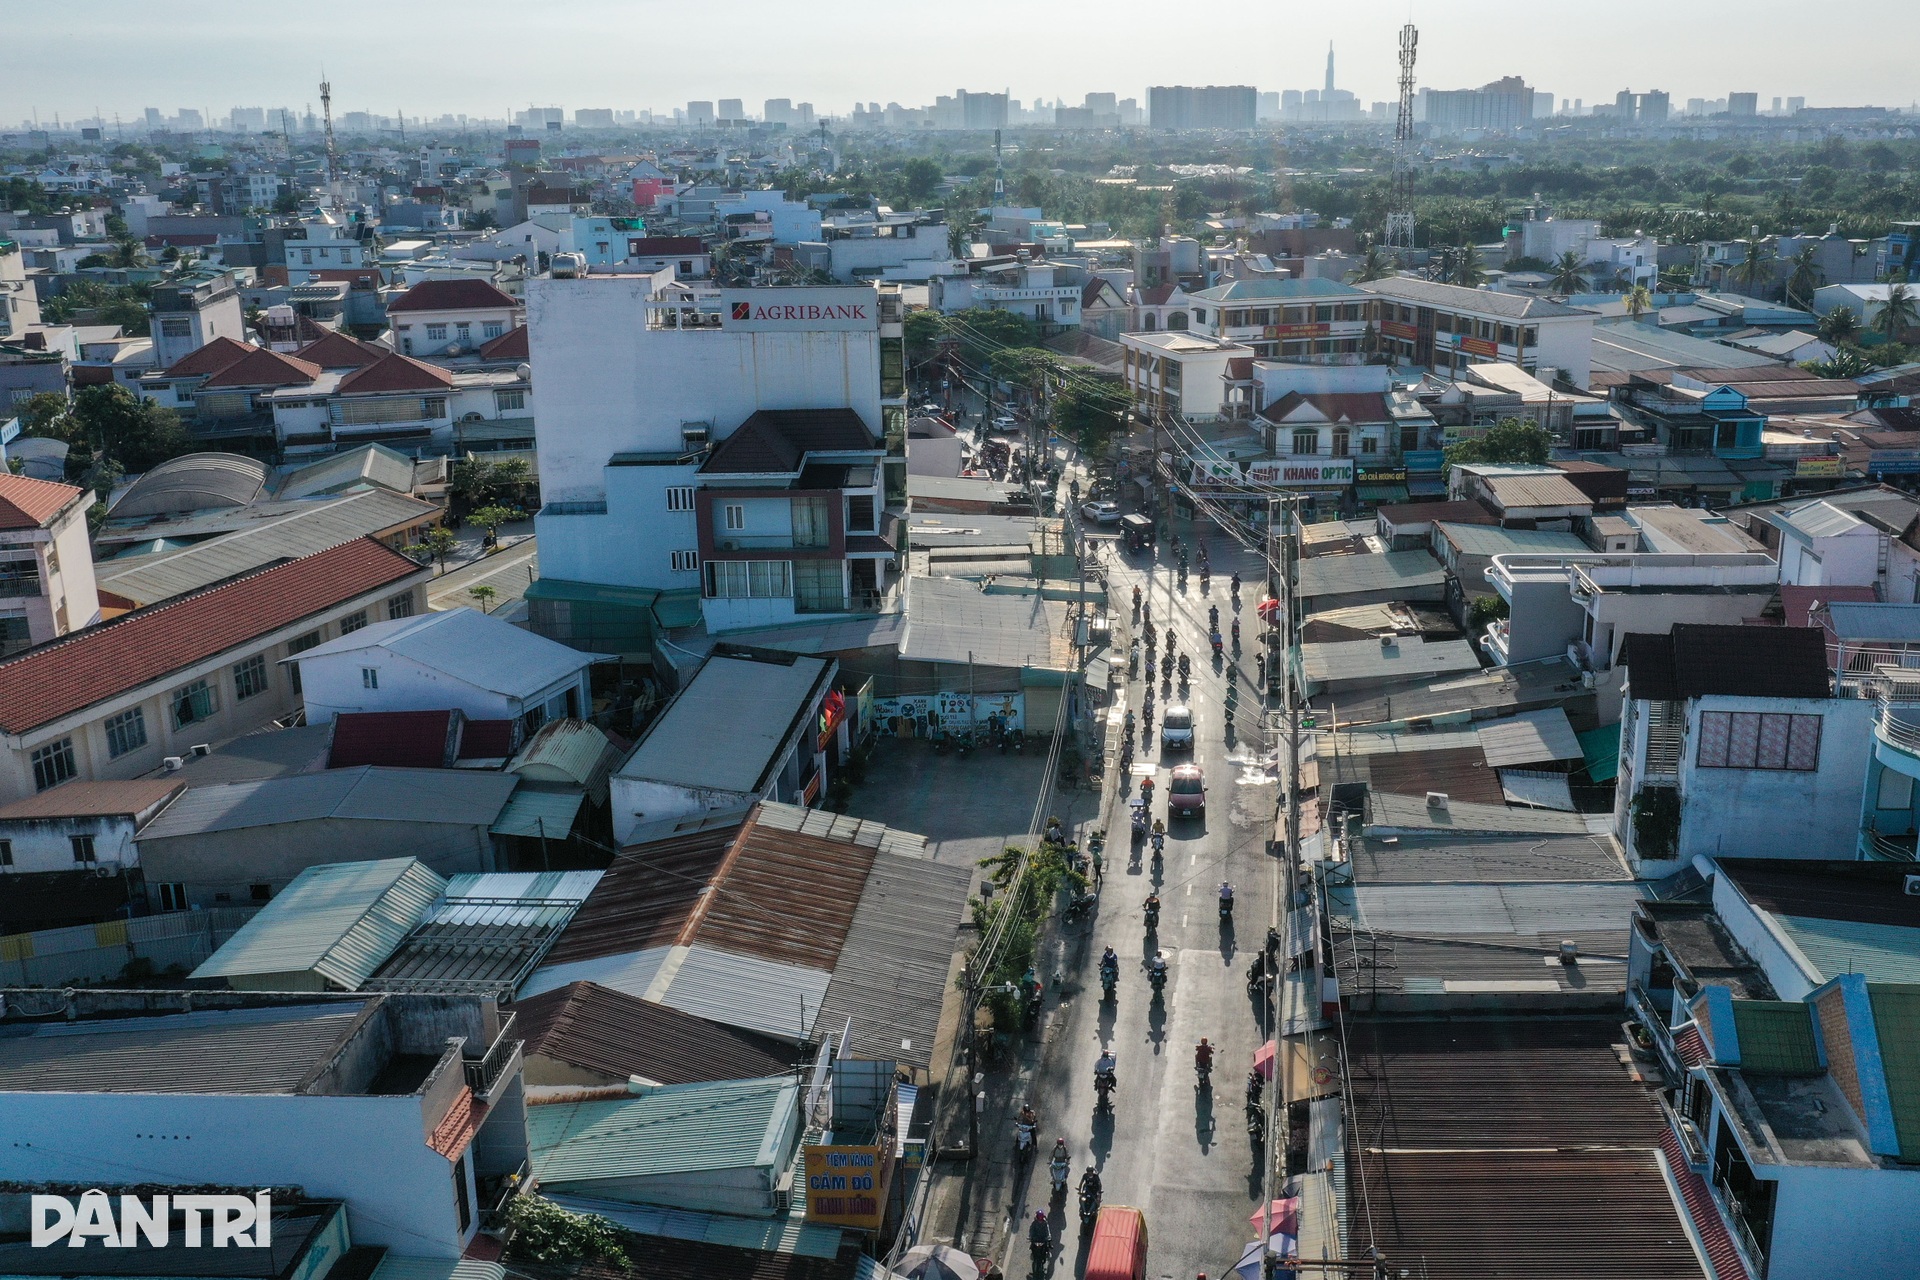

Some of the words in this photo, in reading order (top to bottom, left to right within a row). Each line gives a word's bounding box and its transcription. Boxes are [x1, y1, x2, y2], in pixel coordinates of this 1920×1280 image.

[754, 305, 867, 320] AGRIBANK
[1252, 466, 1280, 483] NHẬT
[1283, 467, 1319, 480] KHANG
[1322, 466, 1352, 480] OPTIC
[825, 1151, 848, 1169] TIỆM
[850, 1151, 874, 1167] VÀNG
[810, 1171, 846, 1190] CẦM
[851, 1171, 874, 1191] ĐỒ
